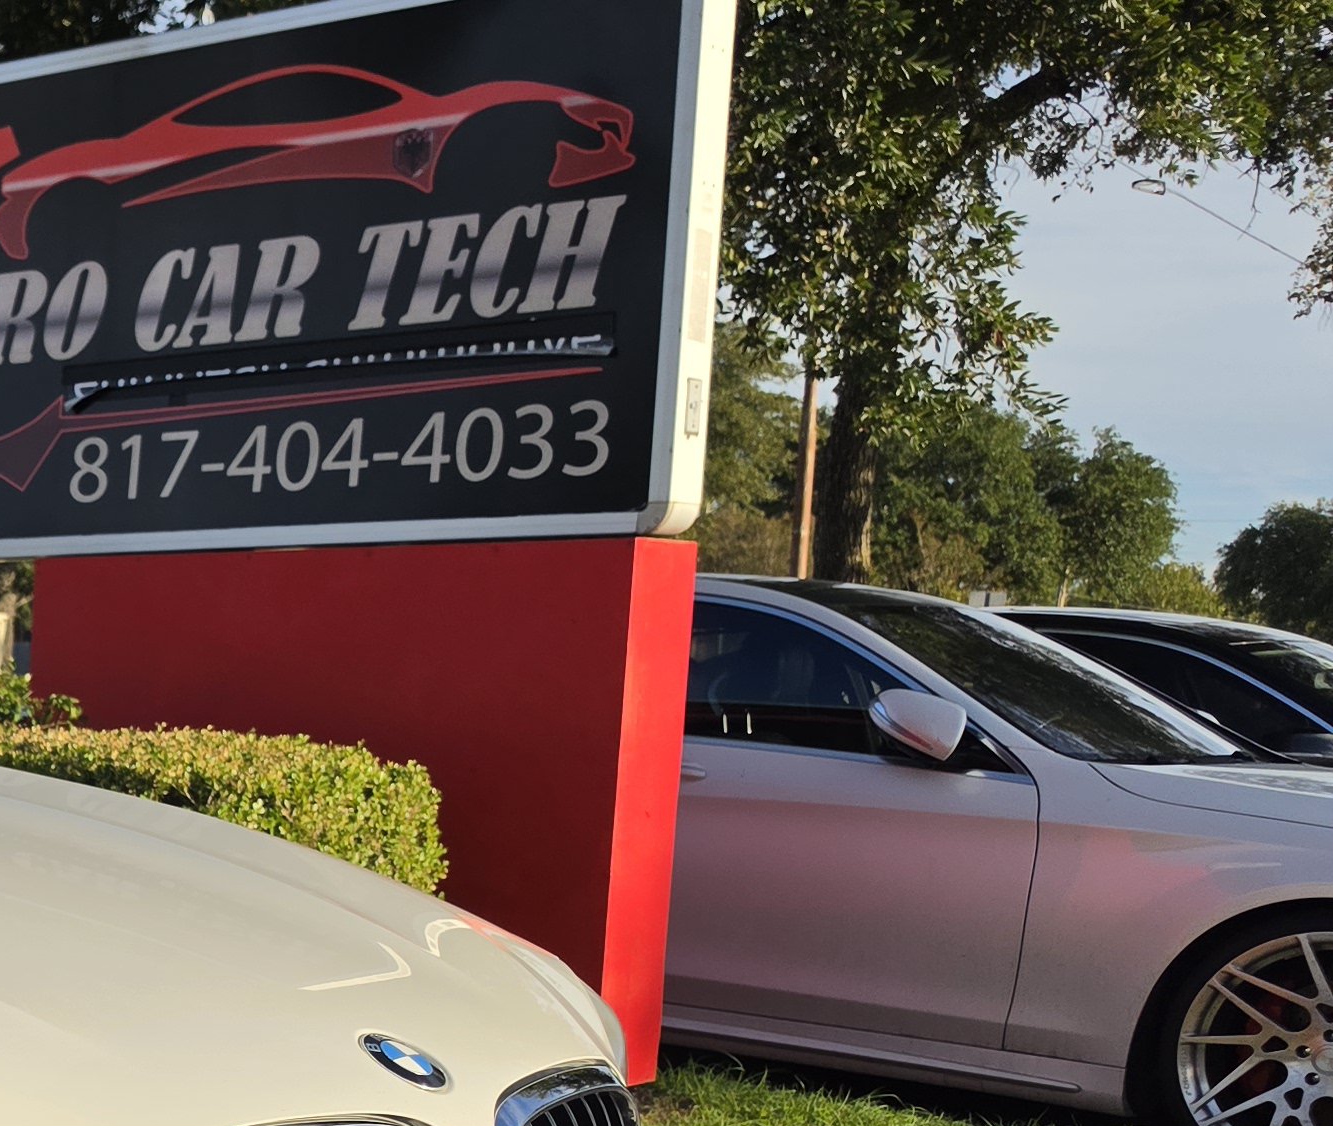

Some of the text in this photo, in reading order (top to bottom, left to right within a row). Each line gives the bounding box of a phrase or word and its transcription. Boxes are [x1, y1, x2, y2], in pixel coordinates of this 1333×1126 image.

[133, 235, 320, 353] CAR
[348, 195, 627, 332] TECH
[69, 400, 610, 503] 817-404-4033
